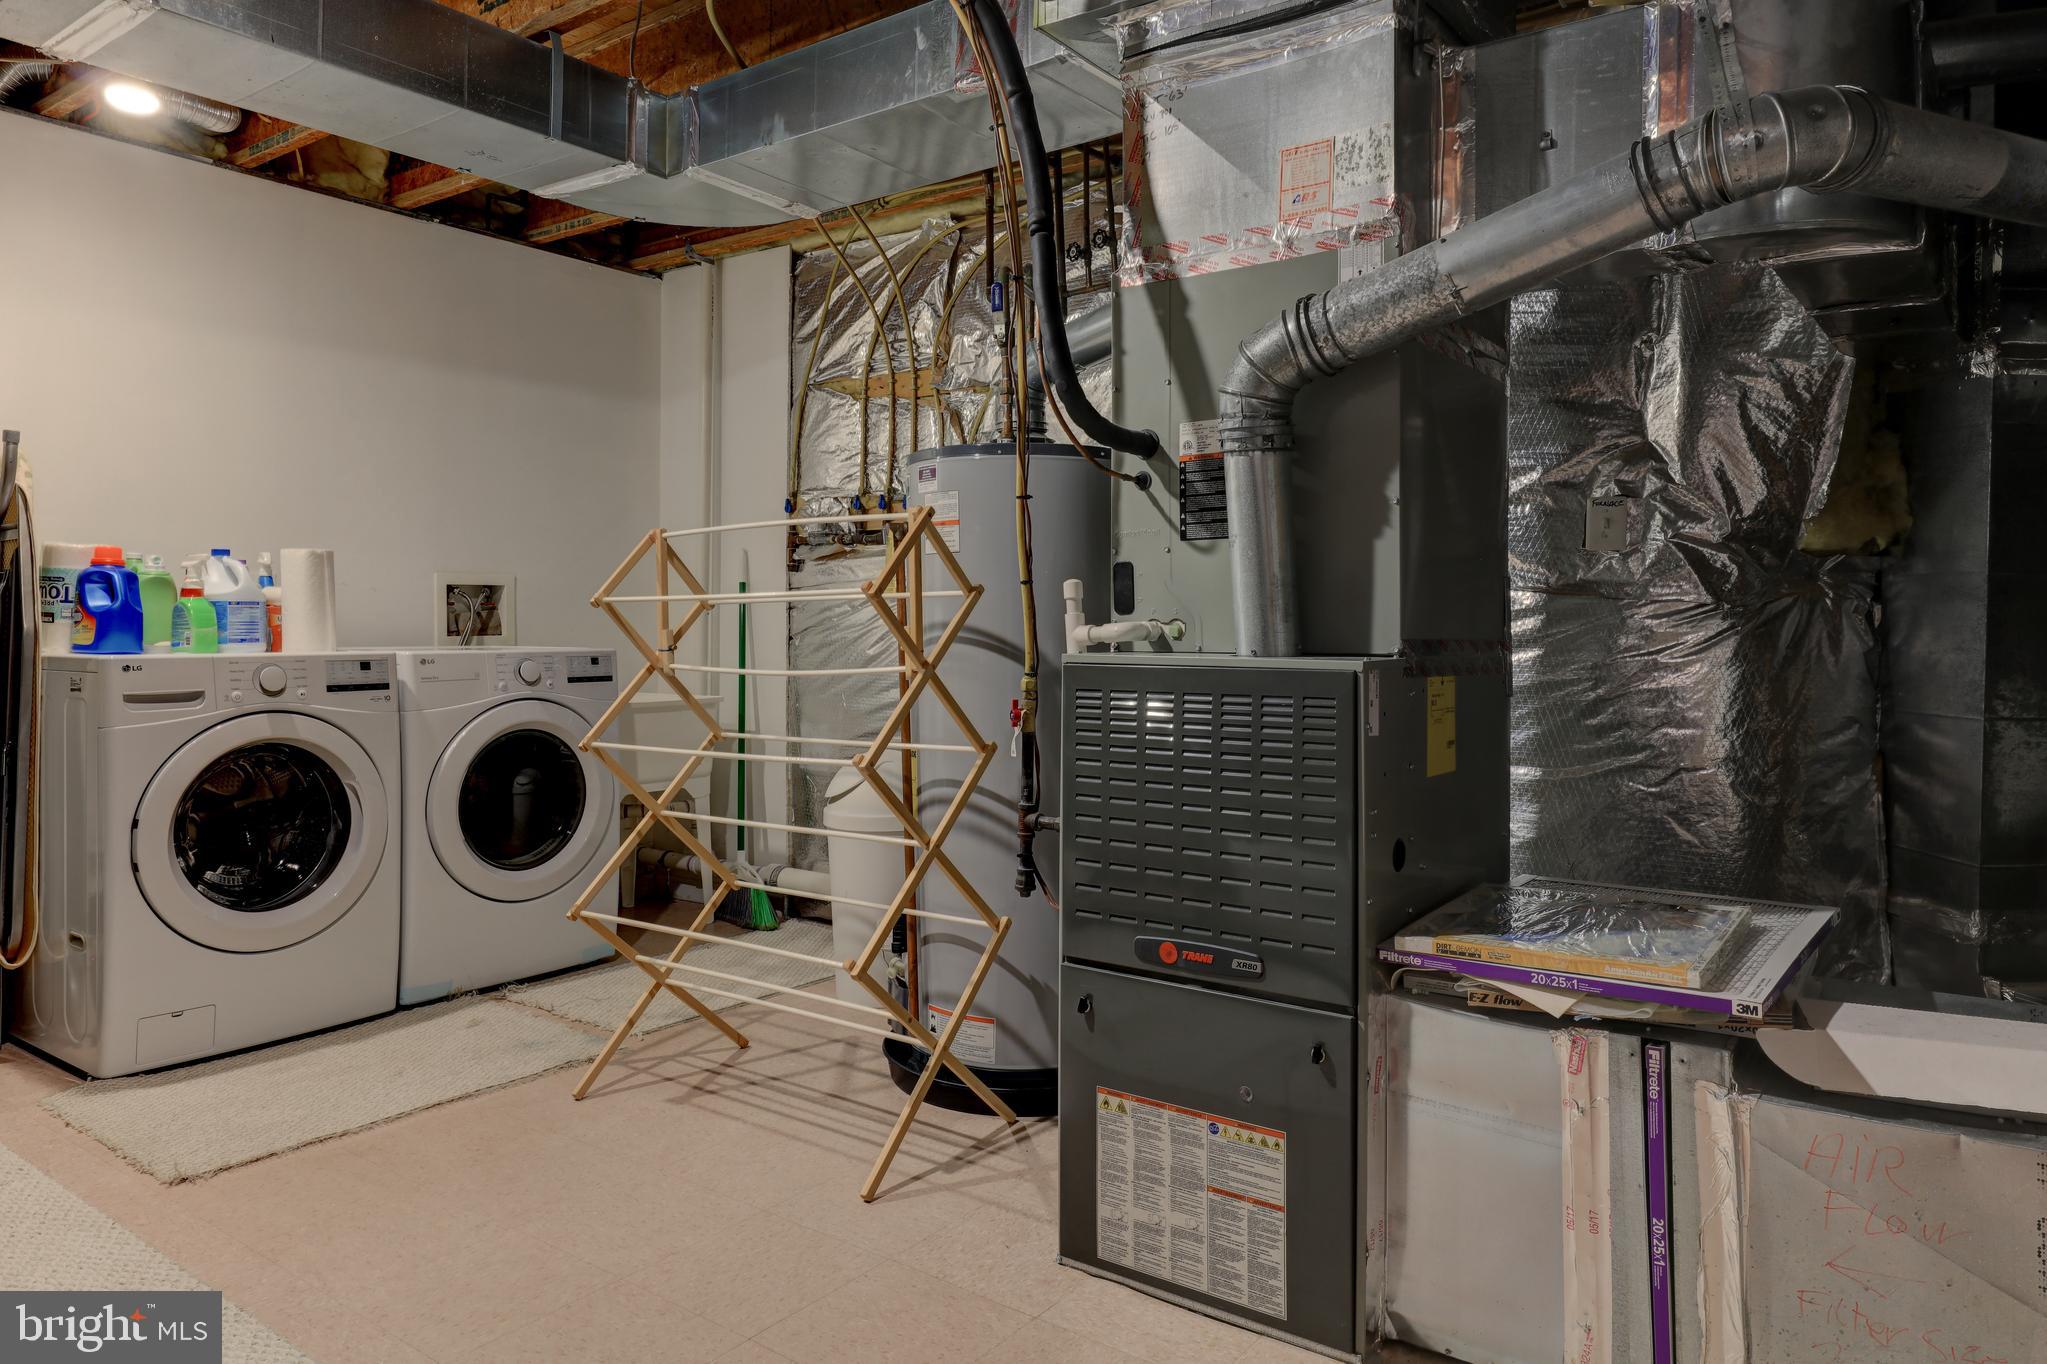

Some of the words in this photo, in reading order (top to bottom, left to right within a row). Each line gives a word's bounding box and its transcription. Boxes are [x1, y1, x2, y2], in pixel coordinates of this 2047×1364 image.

[1435, 942, 1452, 950] DIRT
[1181, 950, 1215, 965] TRANE
[1378, 950, 1422, 967] Filtrete
[1235, 961, 1258, 971] XR80
[1530, 973, 1578, 990] 20x25x1
[1469, 991, 1488, 1003] E-Z
[1493, 993, 1523, 1007] flow
[1736, 1003, 1759, 1017] 3M
[1648, 1049, 1661, 1100] Filtrete
[1588, 1209, 1599, 1235] 05/17
[1652, 1217, 1665, 1266] 20x25x1
